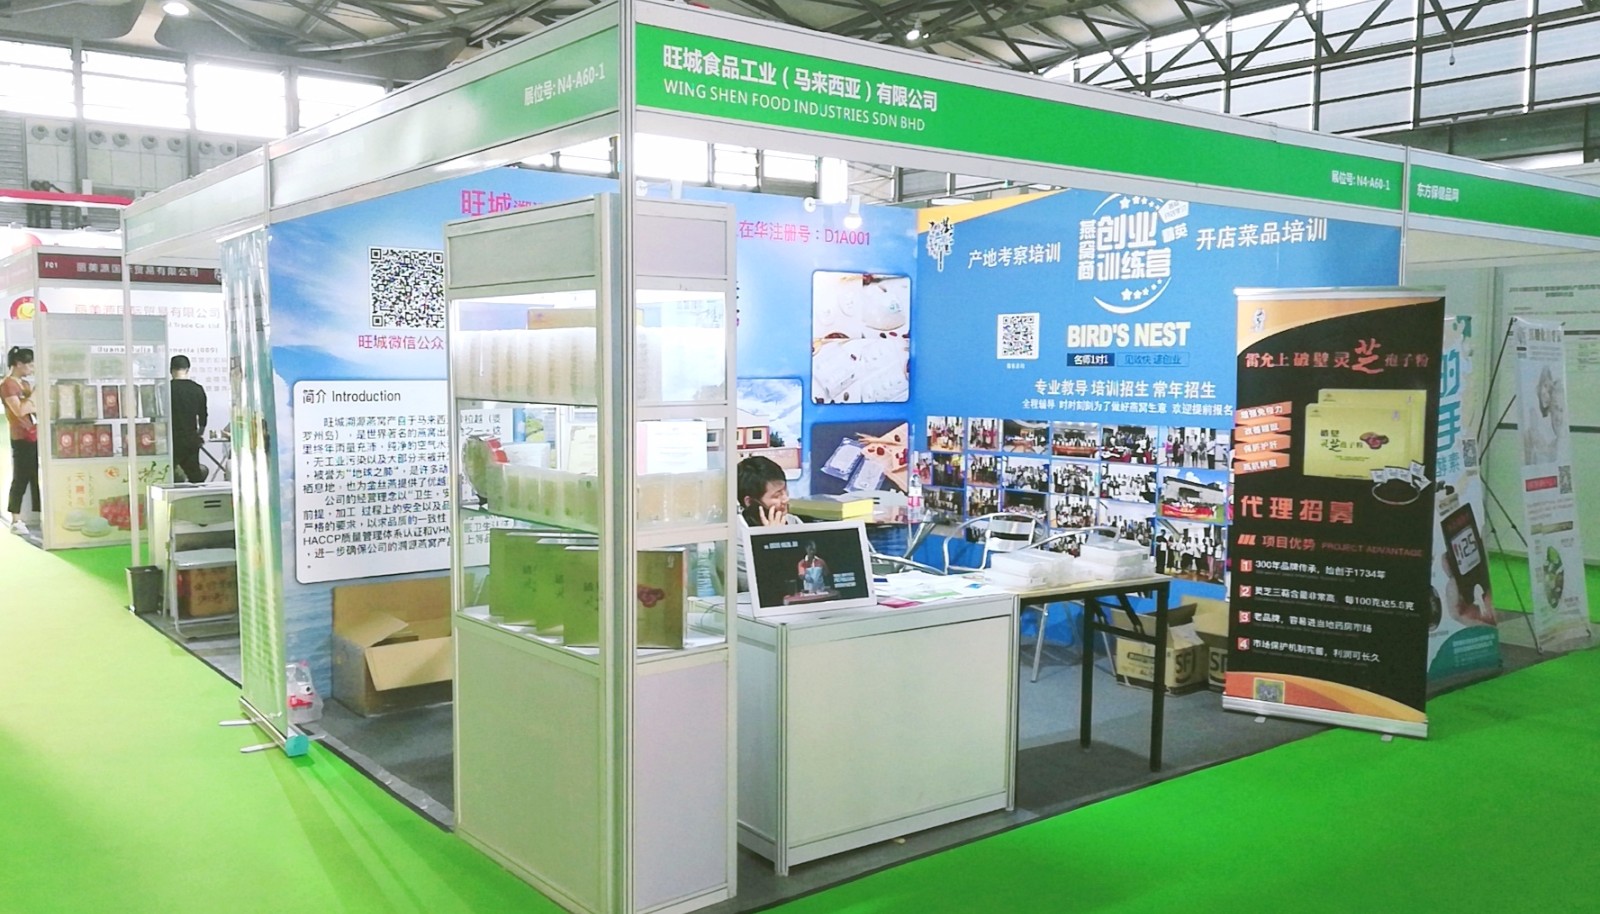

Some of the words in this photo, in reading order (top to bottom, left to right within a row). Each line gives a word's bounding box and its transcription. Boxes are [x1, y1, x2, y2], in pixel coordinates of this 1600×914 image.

[663, 78, 706, 99] WING
[710, 85, 748, 106] SHEN
[752, 92, 791, 111] FOOD
[794, 99, 869, 124] INDUSTRIES
[872, 111, 898, 128] SDN
[900, 116, 925, 131] BHD
[1097, 211, 1157, 251] 创业
[1196, 217, 1328, 252] 开店菜品培训
[968, 242, 1061, 269] 产地考察培训
[1097, 248, 1171, 281] 训练营
[358, 334, 444, 350] 旺城微信公众
[1067, 325, 1130, 348] BIRD'S
[1134, 321, 1191, 347] NEST
[303, 389, 327, 404] 简介
[332, 390, 401, 403] Introduction
[1034, 378, 1088, 397] 专业教导
[1091, 379, 1149, 398] 培训招生
[1152, 381, 1216, 399] 常年招生
[1240, 495, 1354, 524] 代理招募
[1261, 535, 1316, 551] 项目优势
